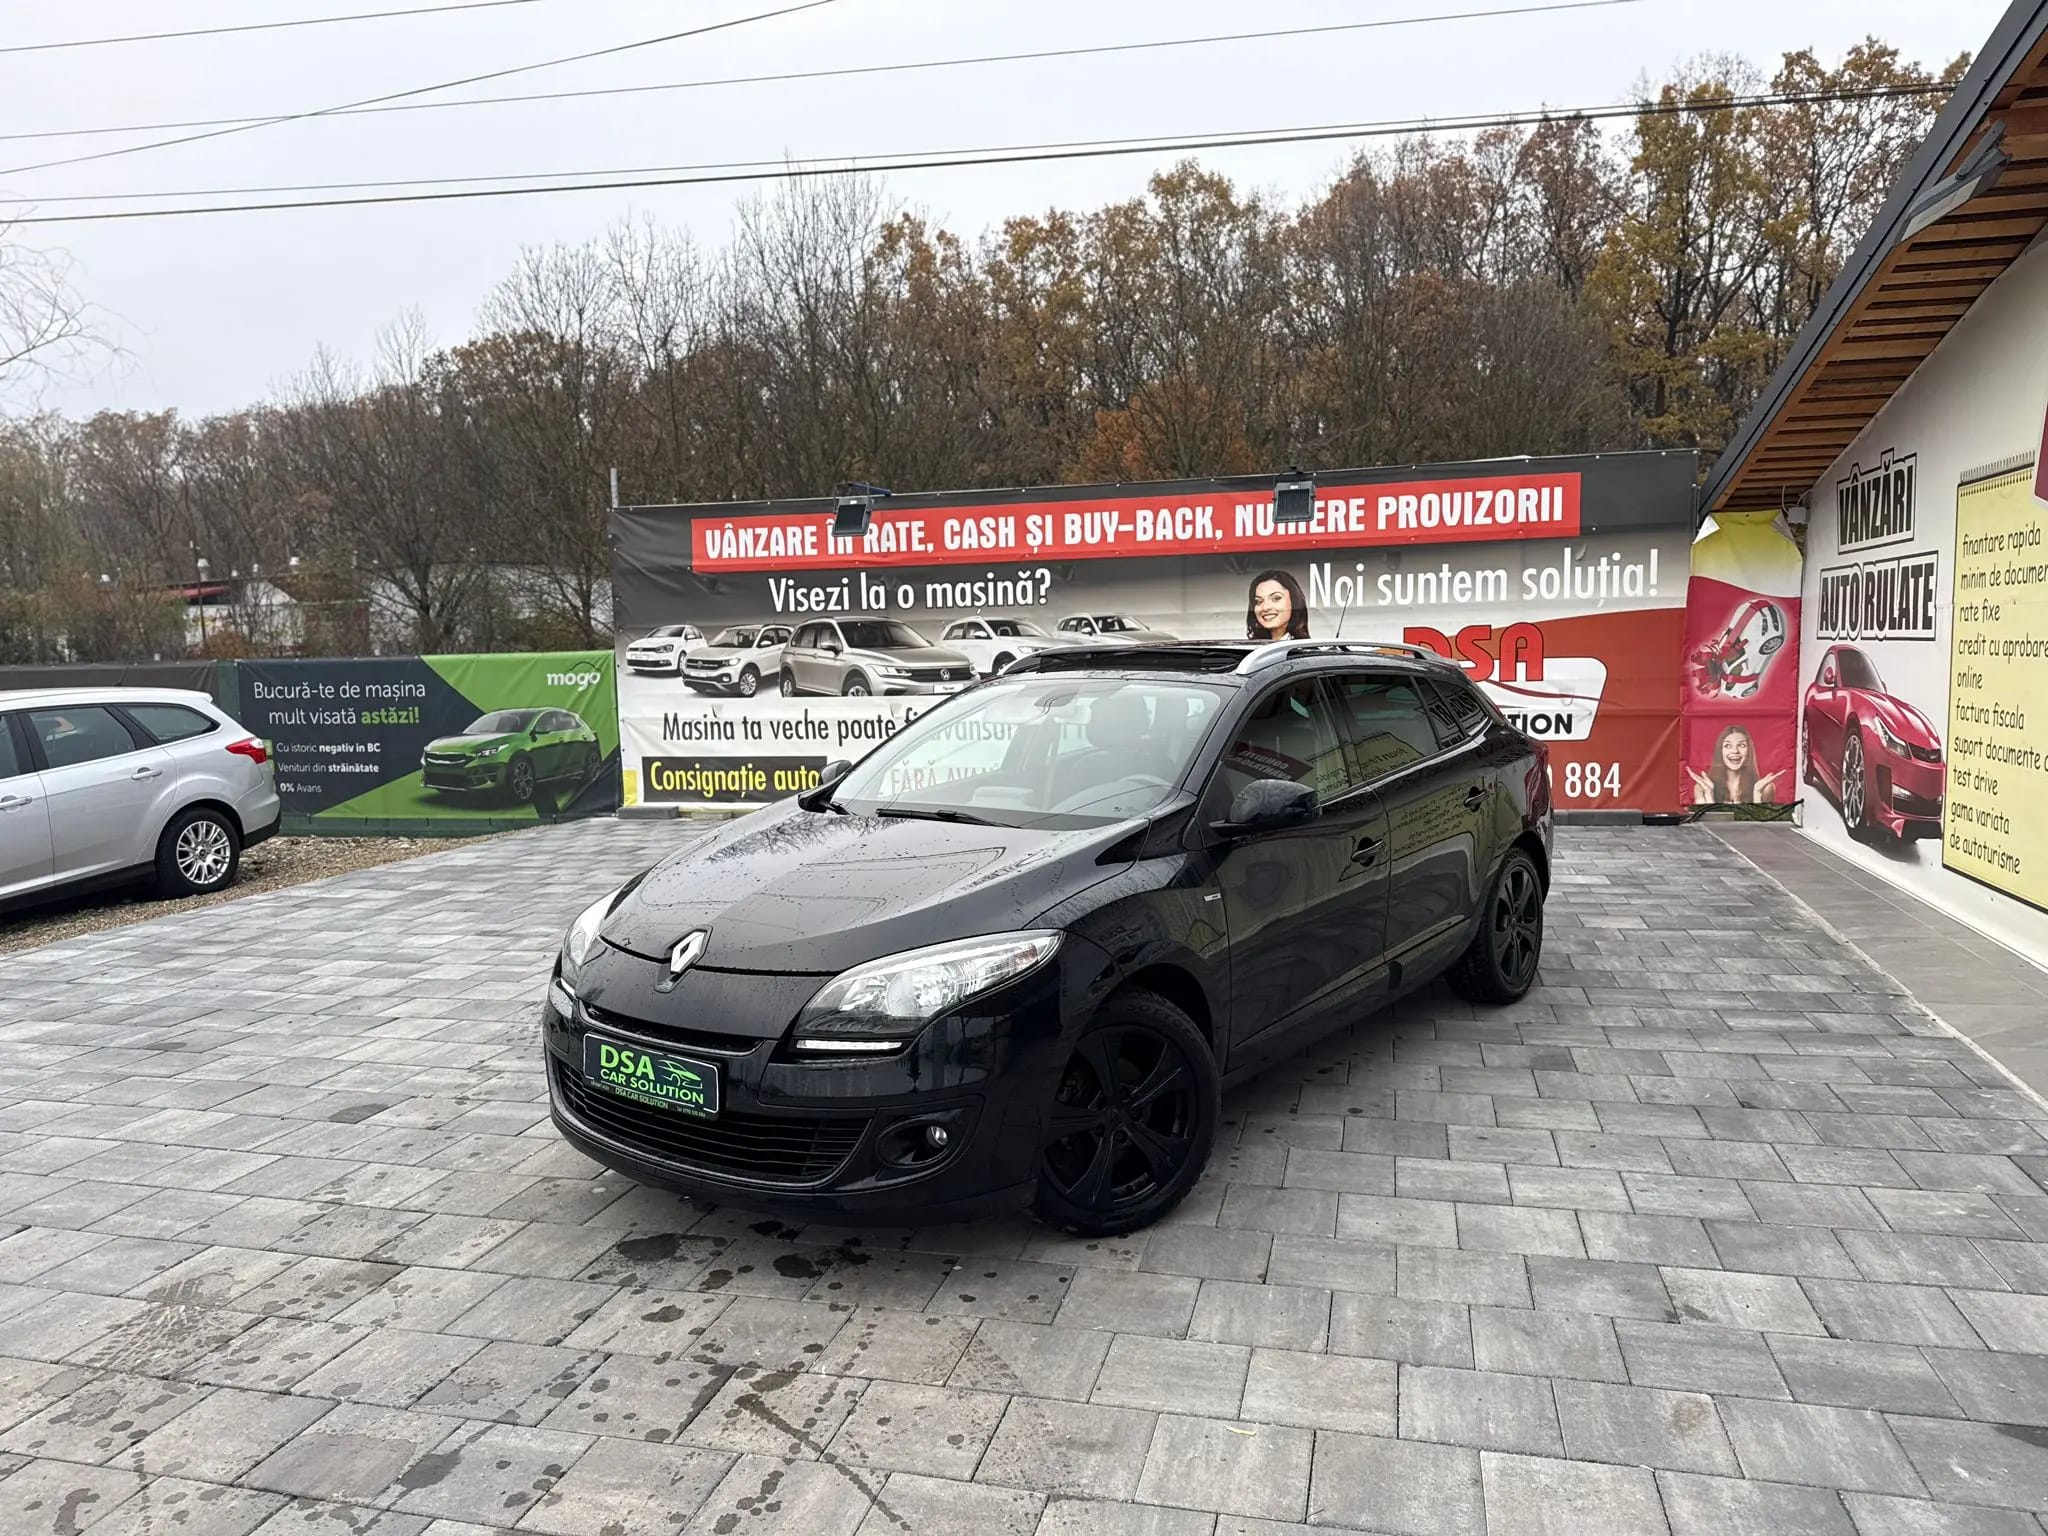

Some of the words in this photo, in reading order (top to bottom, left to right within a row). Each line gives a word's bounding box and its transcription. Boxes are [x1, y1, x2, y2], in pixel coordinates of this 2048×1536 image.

[1839, 460, 1914, 545] VÂNZĂRI
[705, 522, 818, 560] VÂNZARE
[864, 520, 934, 553] RATE,
[943, 516, 1015, 550] CASH
[1025, 514, 1053, 554] ȘI
[1064, 506, 1223, 546] BUY-BACK,
[1377, 486, 1563, 531] PROVIZORII
[1963, 532, 2005, 558] finantare
[2008, 521, 2041, 556] rapida
[768, 577, 850, 612] Visezi
[860, 572, 886, 610] la
[897, 583, 915, 609] o
[926, 567, 1051, 614] mașină?
[1309, 563, 1365, 607] Noi
[1377, 563, 1508, 606] suntem
[1522, 547, 1658, 608] soluția!
[1960, 567, 1986, 590] minim
[1989, 562, 2001, 587] de
[1819, 571, 1860, 632] AUTO
[1863, 562, 1935, 631] RULATE
[1959, 602, 1979, 622] rate
[1982, 598, 2000, 623] fixe
[1958, 632, 1986, 656] credit
[1989, 640, 2000, 656] cu
[253, 681, 335, 699] Bucură-te
[339, 681, 361, 699] de
[365, 680, 426, 702] mașina
[546, 672, 601, 692] mogo
[1956, 665, 1983, 690] online
[269, 708, 307, 725] mult
[309, 707, 356, 725] visată
[361, 706, 420, 725] astăzi!
[742, 715, 762, 741] ta
[770, 709, 829, 740] veche
[837, 714, 896, 747] poate
[1506, 713, 1573, 734] TION
[1955, 697, 1990, 725] factura
[1992, 701, 2025, 730] fiscala
[276, 743, 290, 752] Cu
[291, 742, 317, 752] istoric
[319, 743, 354, 755] negativ
[367, 743, 381, 752] BC
[1953, 736, 1984, 760] suport
[1986, 736, 2041, 770] documente
[277, 762, 311, 772] Venituri
[312, 762, 326, 772] din
[328, 763, 379, 773] străinătate
[650, 761, 767, 798] Consignație
[773, 765, 820, 791] auto
[1564, 762, 1621, 798] 884
[1953, 764, 1971, 787] test
[1974, 768, 1998, 795] drive
[280, 782, 295, 792] 0%
[296, 783, 322, 792] Avans
[1951, 801, 1973, 823] gama
[1975, 808, 2009, 835] variata
[1950, 827, 1961, 851] de
[1963, 838, 2021, 875] autoturisme
[600, 1044, 655, 1081] DSA
[600, 1068, 626, 1086] CAR
[630, 1075, 704, 1105] SOLUTION
